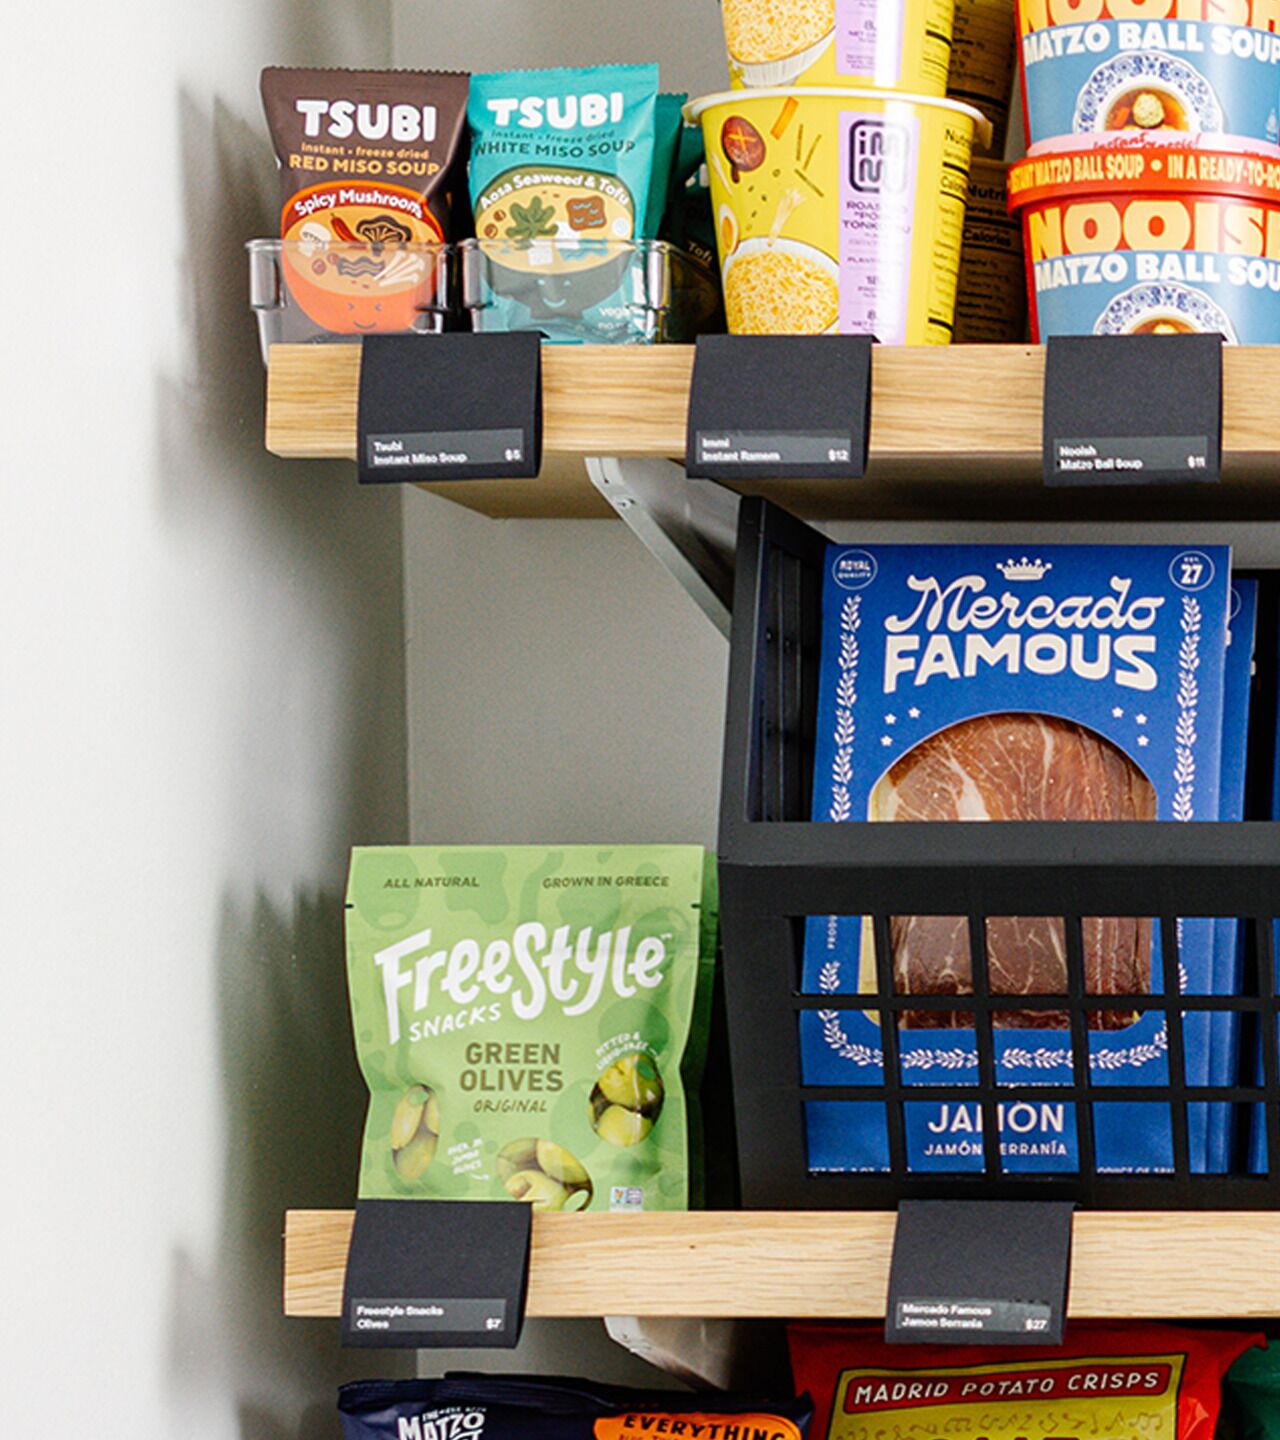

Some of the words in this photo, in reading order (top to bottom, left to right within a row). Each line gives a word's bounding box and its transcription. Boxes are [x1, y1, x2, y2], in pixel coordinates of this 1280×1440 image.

[1023, 23, 1110, 66] MATZO
[1118, 23, 1203, 51] BALL
[296, 100, 436, 141] TSUBI
[290, 154, 329, 171] RED
[333, 159, 382, 173] MISO
[386, 160, 440, 176] SOUP
[884, 575, 1164, 632] Mercado
[883, 635, 1158, 694] FAMOUS
[384, 878, 408, 888] ALL
[414, 878, 479, 888] NATURAL
[544, 878, 593, 888] GROWN
[598, 878, 612, 887] IN
[617, 877, 669, 887] GREECE
[408, 1004, 501, 1043] SNACKS
[466, 1043, 560, 1065] GREEN
[460, 1070, 563, 1092] OLIVES
[473, 1100, 547, 1114] ORIGINAL
[855, 1382, 948, 1404] MADRID
[961, 1378, 1054, 1396] POTATO
[1068, 1372, 1158, 1391] CRISPS
